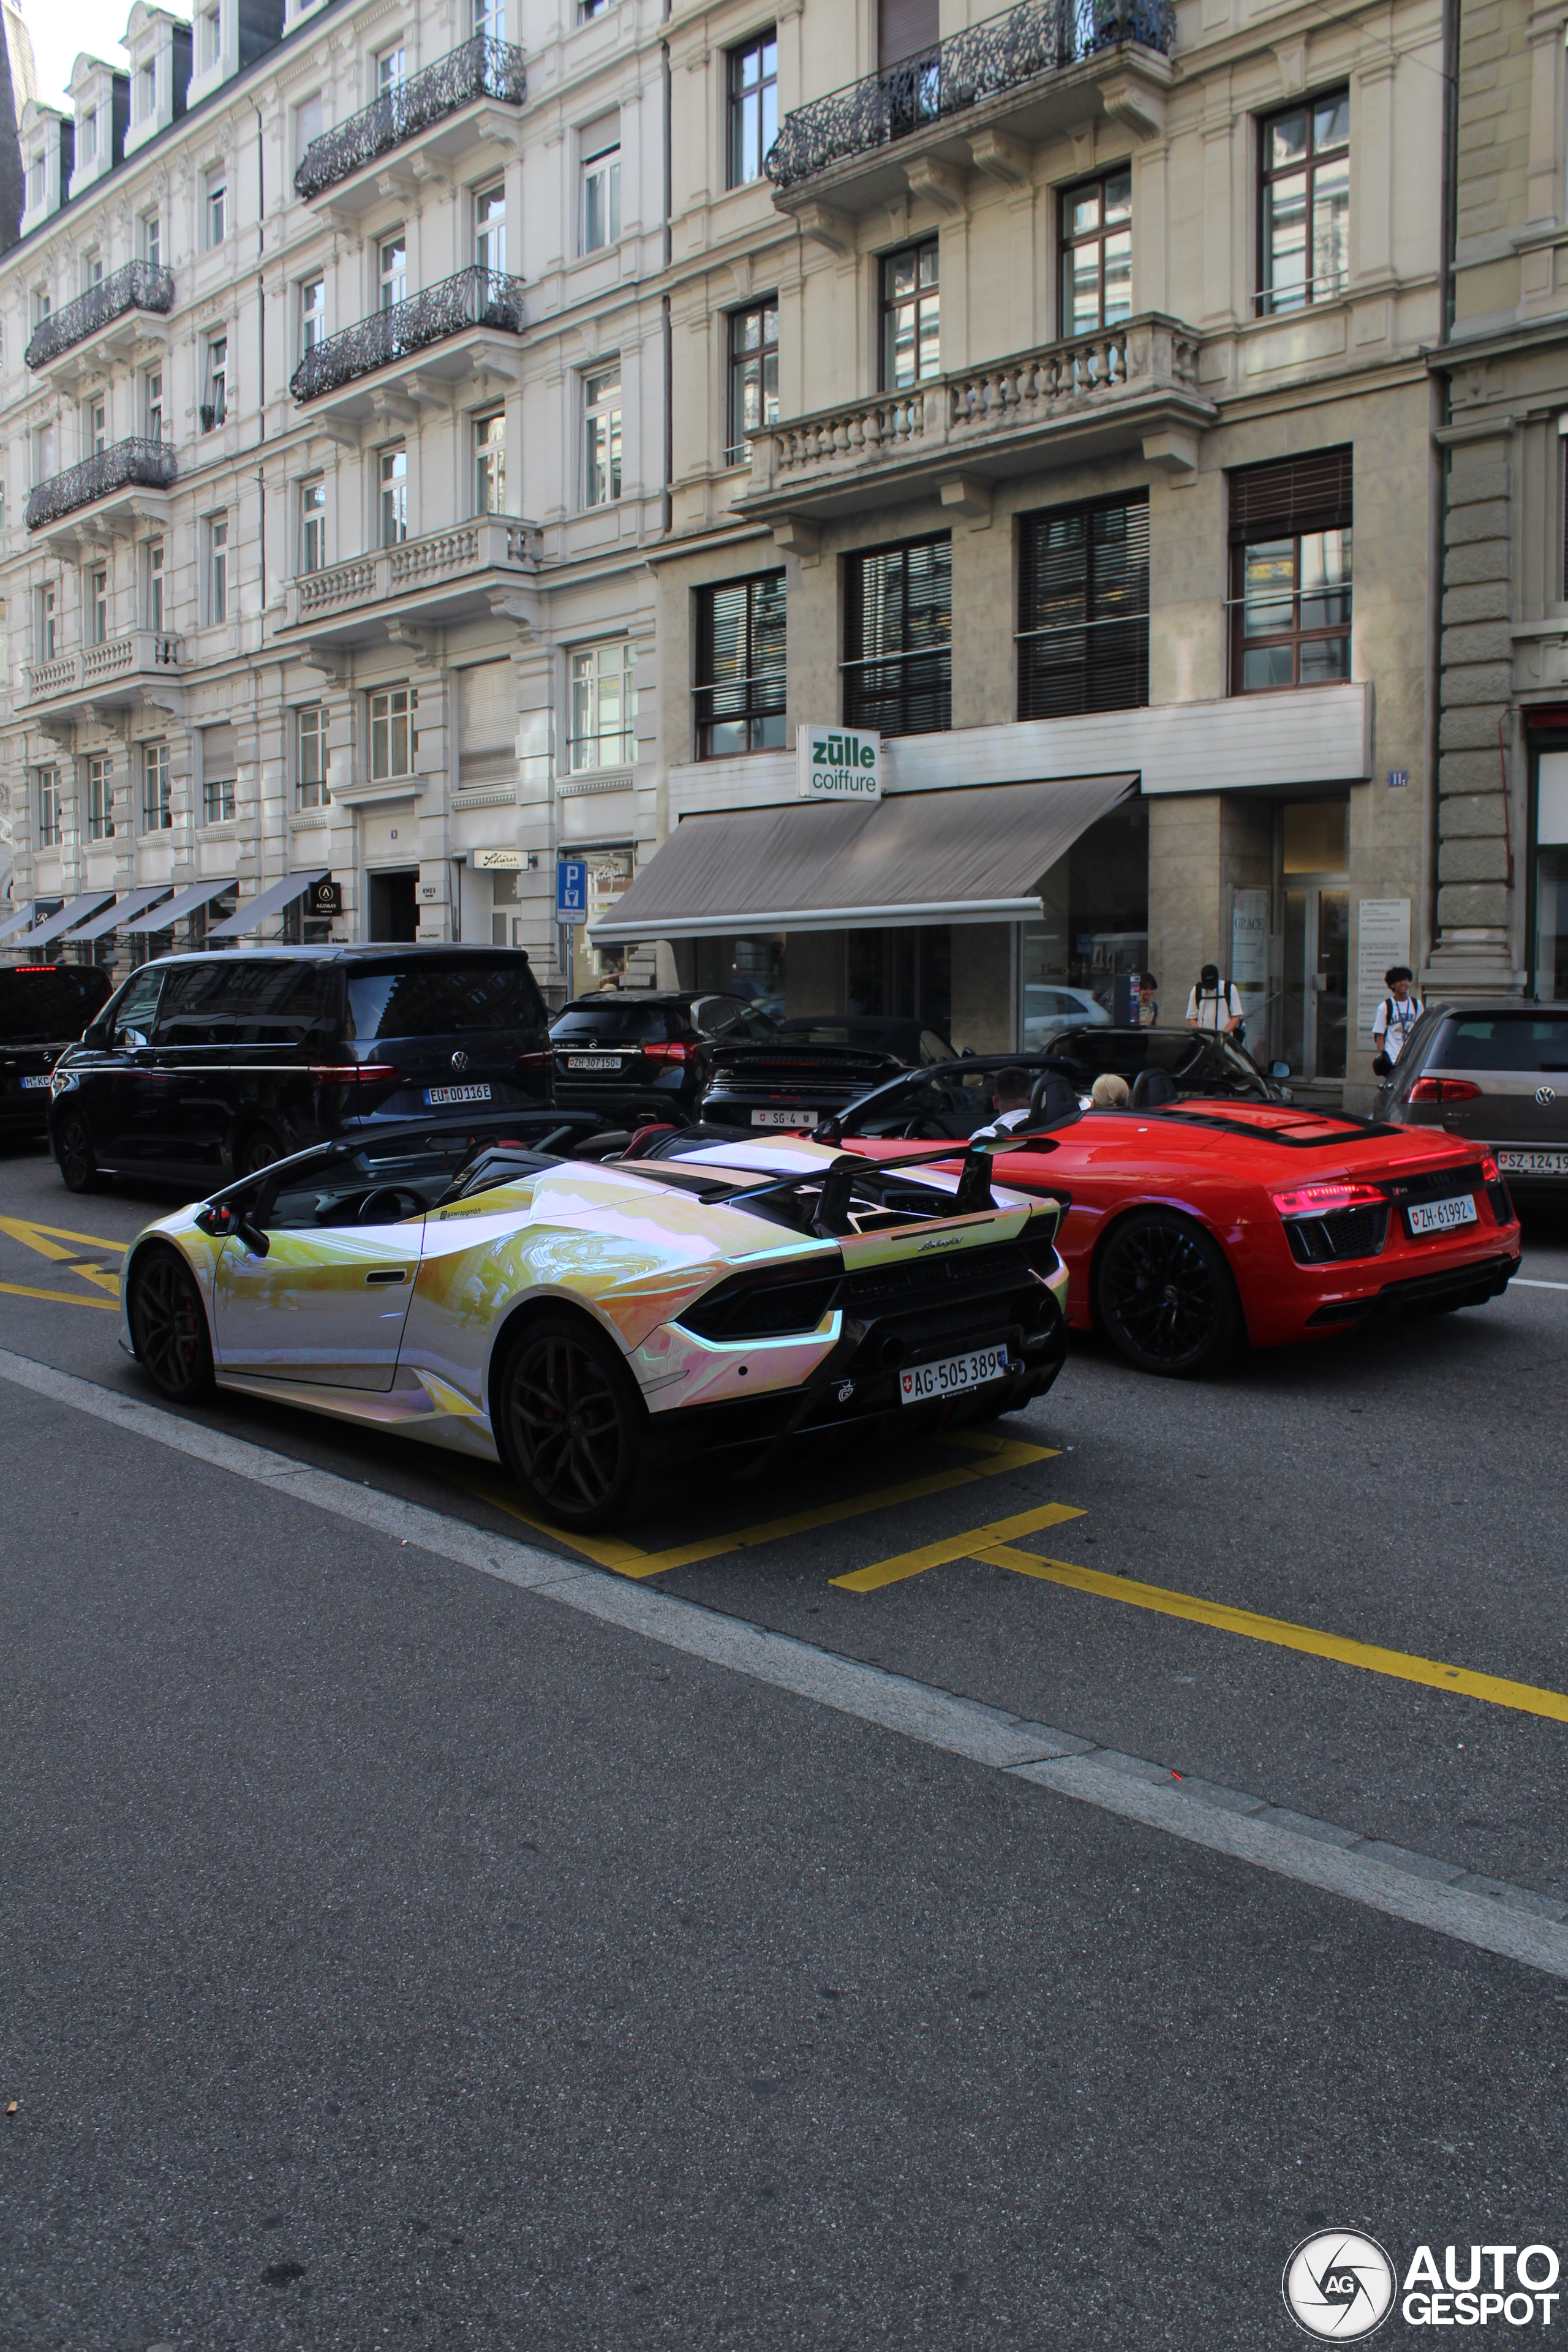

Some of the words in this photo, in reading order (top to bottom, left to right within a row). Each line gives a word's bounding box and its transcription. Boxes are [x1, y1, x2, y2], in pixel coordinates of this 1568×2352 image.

[813, 769, 876, 792] coiffure
[567, 865, 578, 888] P
[1235, 918, 1264, 930] GRACE
[26, 1078, 33, 1087] M
[431, 1090, 445, 1102] EU
[447, 1208, 481, 1218] gowrapgmbh
